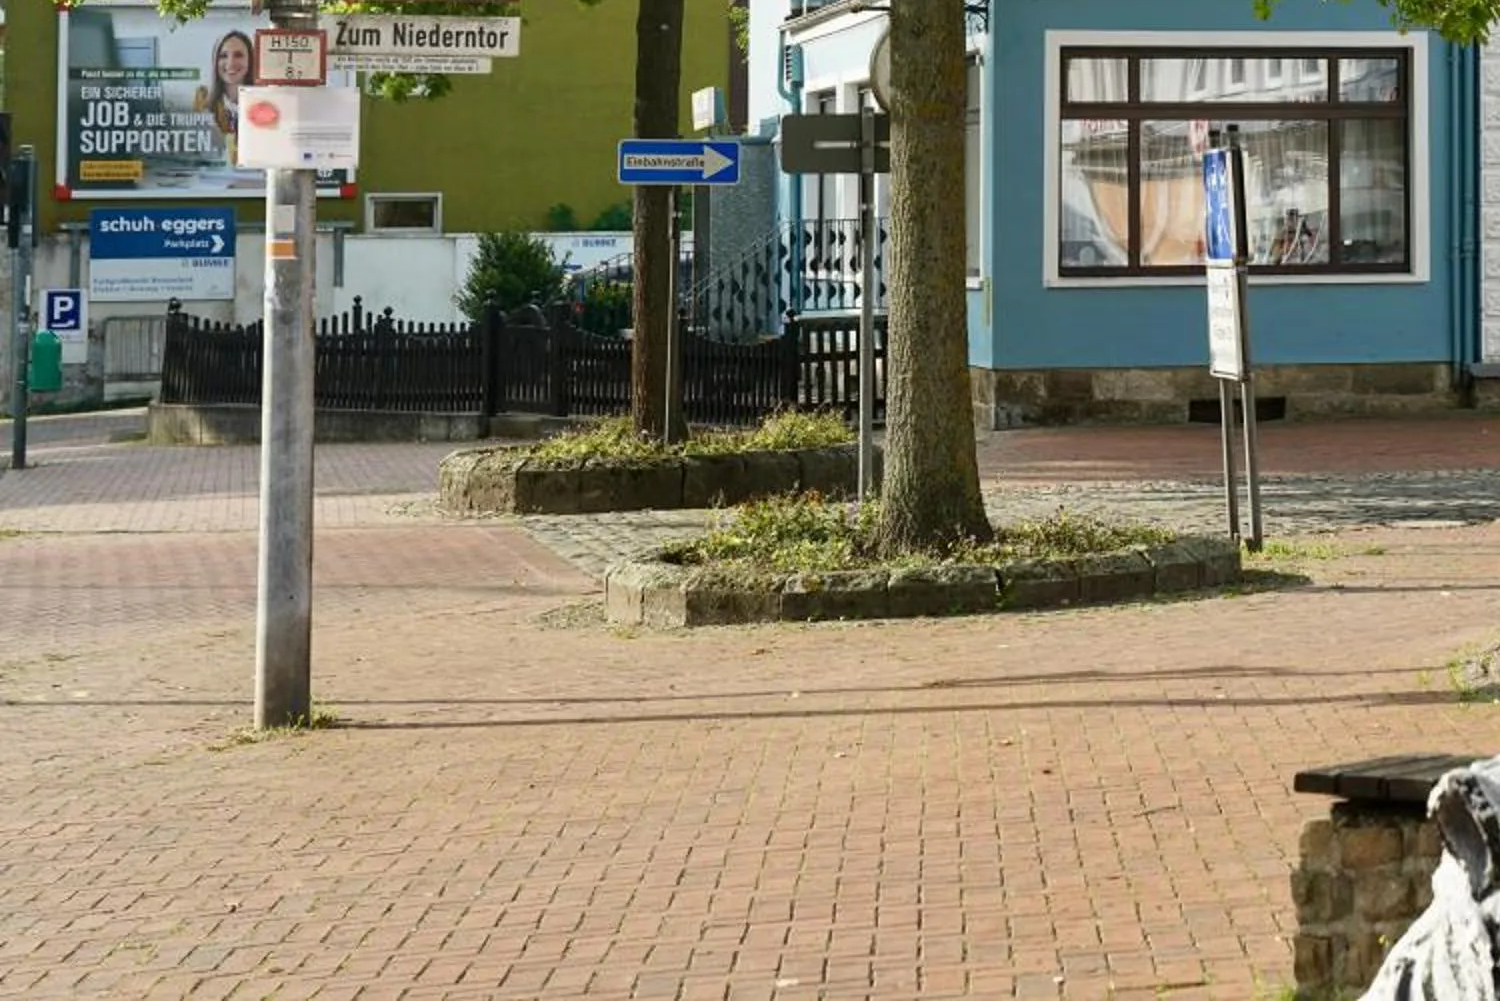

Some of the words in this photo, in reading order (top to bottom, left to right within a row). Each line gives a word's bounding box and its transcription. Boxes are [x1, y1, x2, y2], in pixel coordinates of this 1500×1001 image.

[335, 20, 381, 47] Zum
[393, 21, 509, 49] Niederntor
[81, 86, 101, 100] EIN
[104, 86, 162, 100] SICHERER
[81, 101, 130, 127] JOB
[133, 113, 143, 127] &
[146, 113, 166, 126] DIE
[80, 130, 219, 154] SUPPORTEN.
[627, 156, 705, 168] Einbahnstraße
[99, 215, 156, 233] schuh
[161, 218, 225, 235] eggers
[53, 296, 74, 320] P
